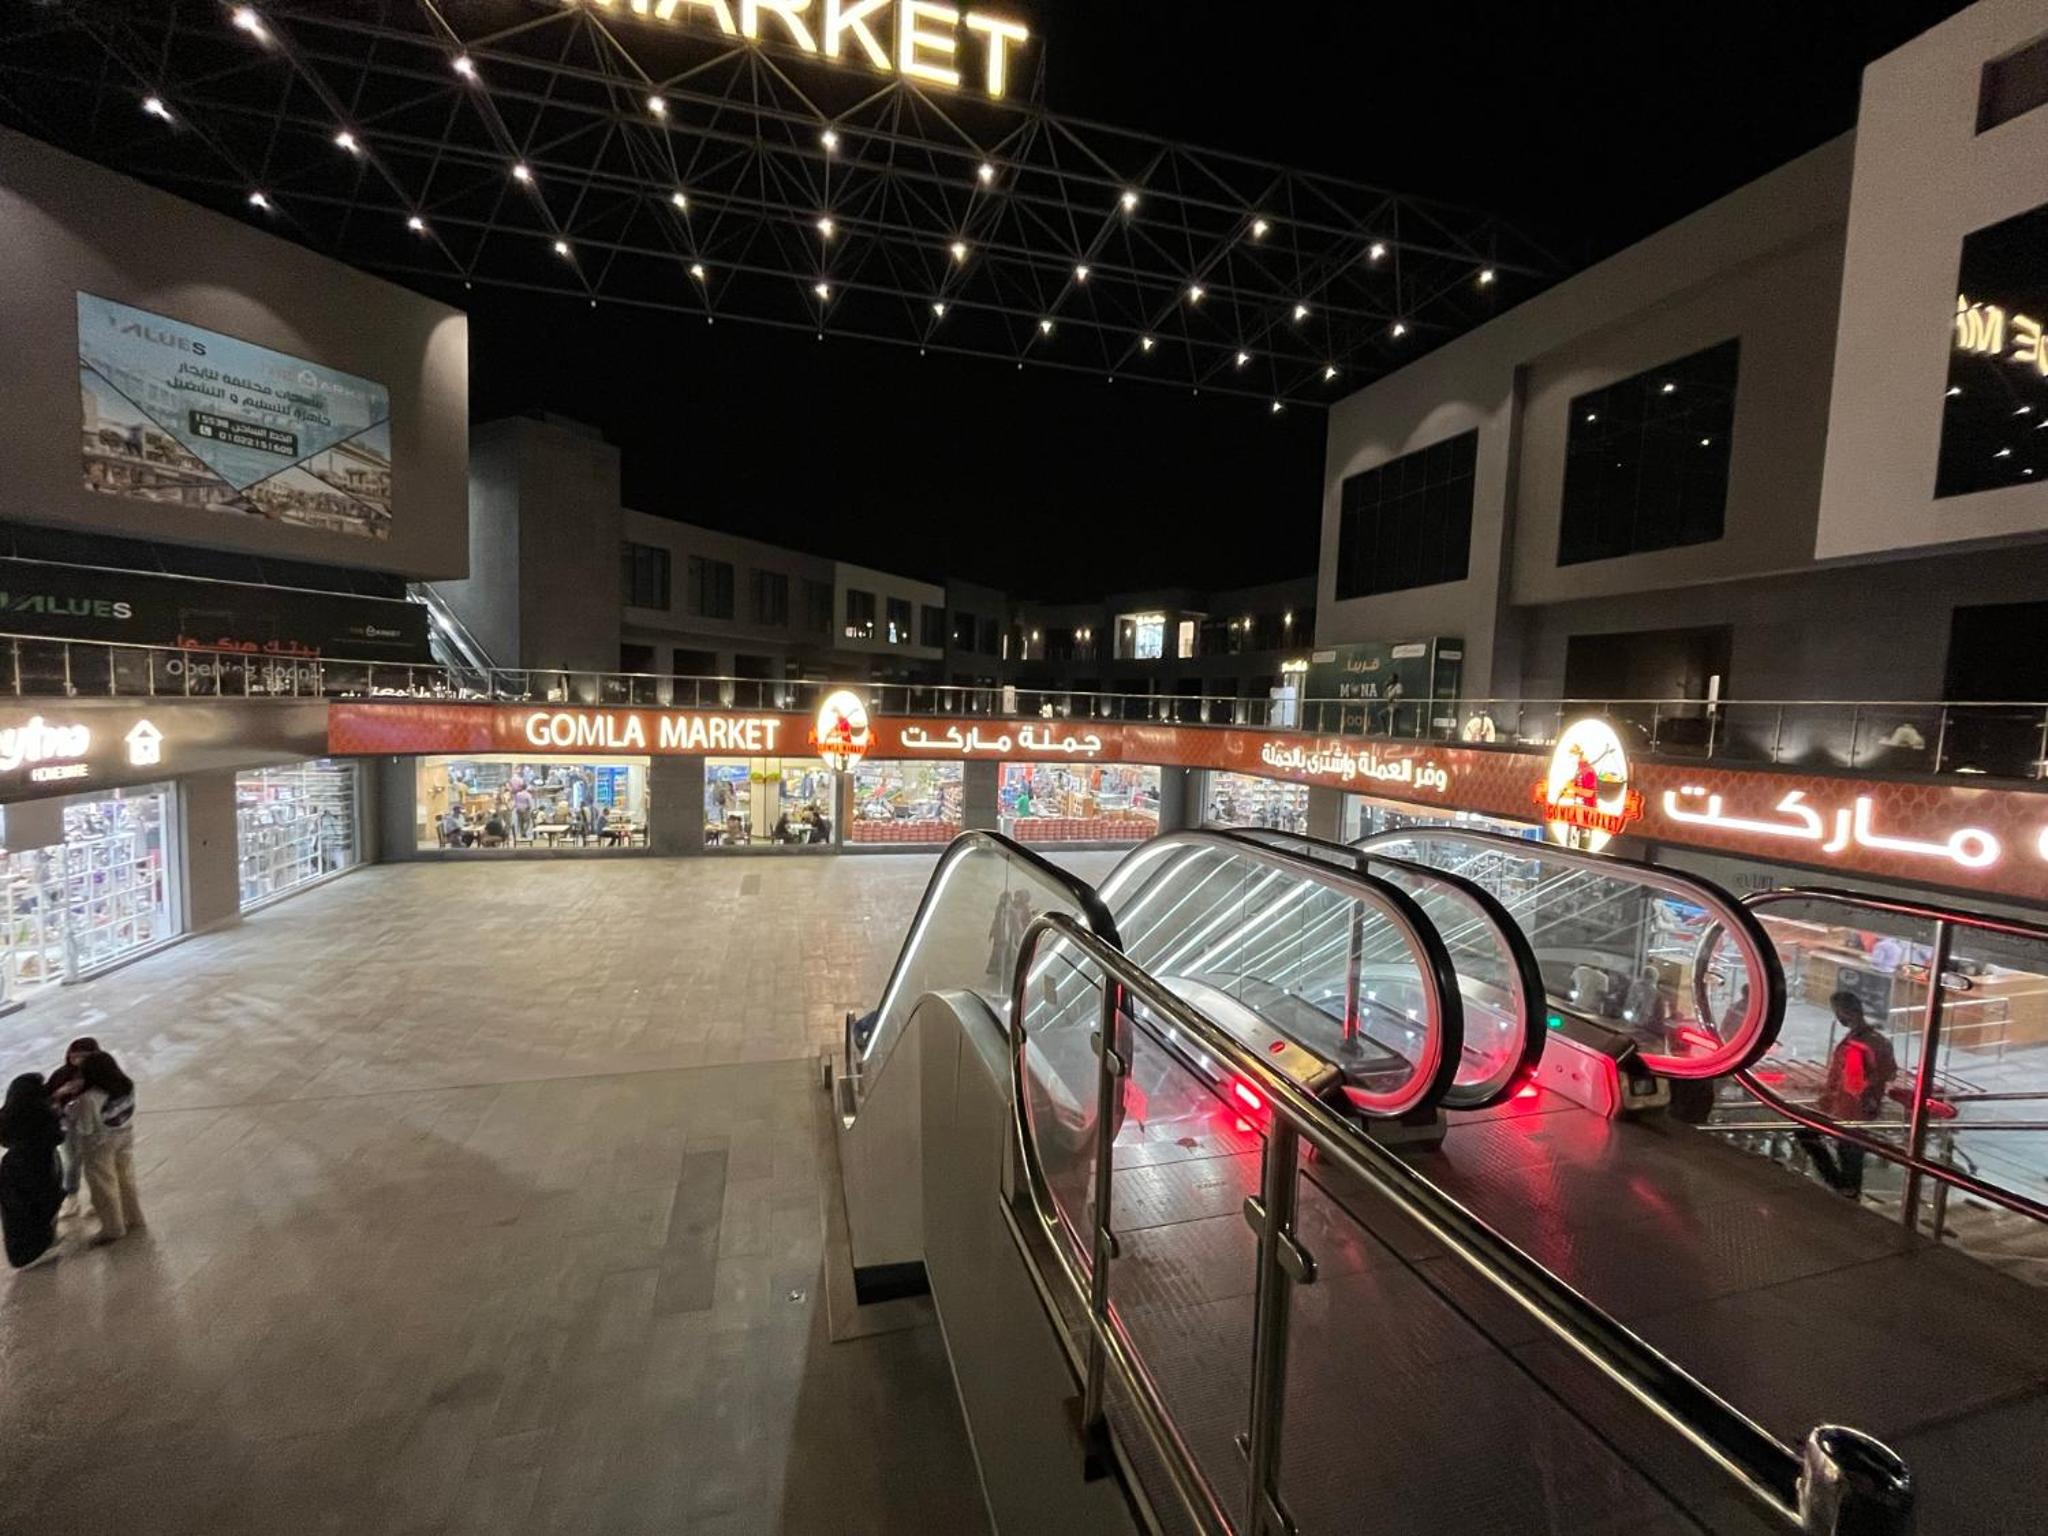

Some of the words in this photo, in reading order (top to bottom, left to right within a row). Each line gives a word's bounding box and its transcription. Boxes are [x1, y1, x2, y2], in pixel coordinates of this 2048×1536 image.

[562, 0, 1030, 98] RKET
[525, 713, 646, 748] GOMLA
[659, 716, 781, 750] MARKET
[901, 726, 1011, 752] ماركت
[1018, 726, 1102, 756] جملة
[1414, 761, 1448, 792] وفر
[1663, 786, 2001, 868] ماركت
